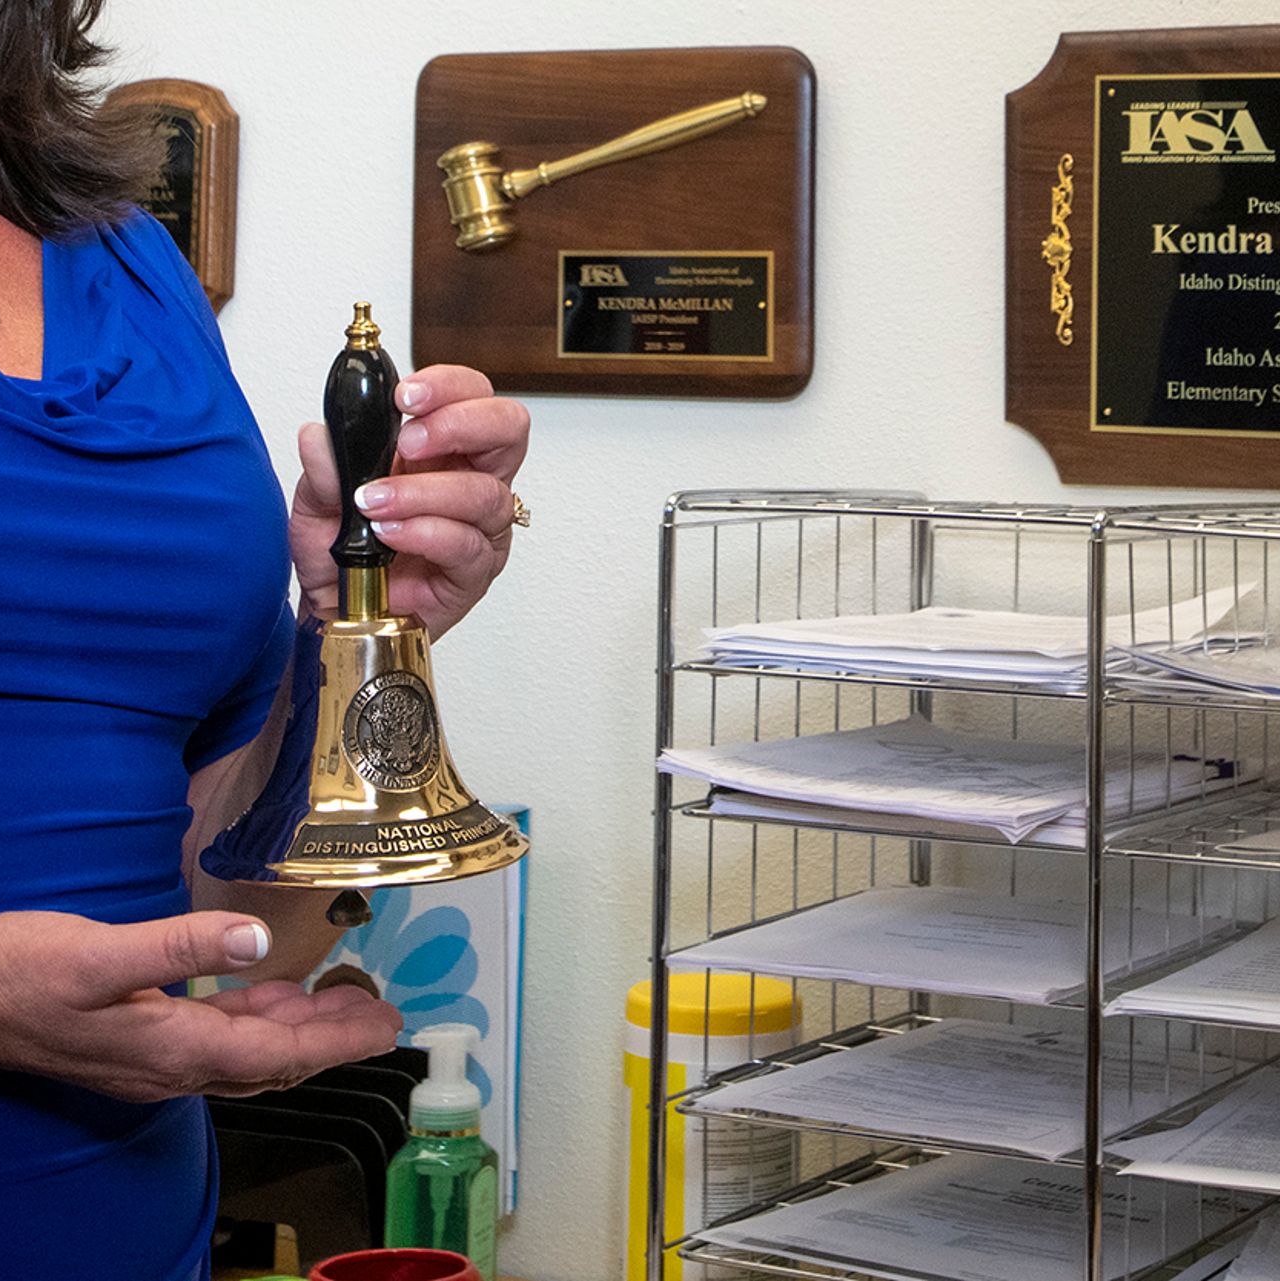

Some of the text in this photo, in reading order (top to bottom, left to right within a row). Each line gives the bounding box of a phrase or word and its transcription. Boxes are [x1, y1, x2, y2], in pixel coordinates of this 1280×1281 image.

[1121, 109, 1276, 155] IASA
[1151, 224, 1273, 254] Kendra
[1180, 273, 1224, 291] Idaho
[597, 296, 733, 311] KENDRA McMILLAN
[1205, 347, 1255, 367] Idaho
[1167, 381, 1267, 407] Elementary
[377, 819, 463, 840] NATIONAL
[303, 836, 447, 855] DISTINGUISHED
